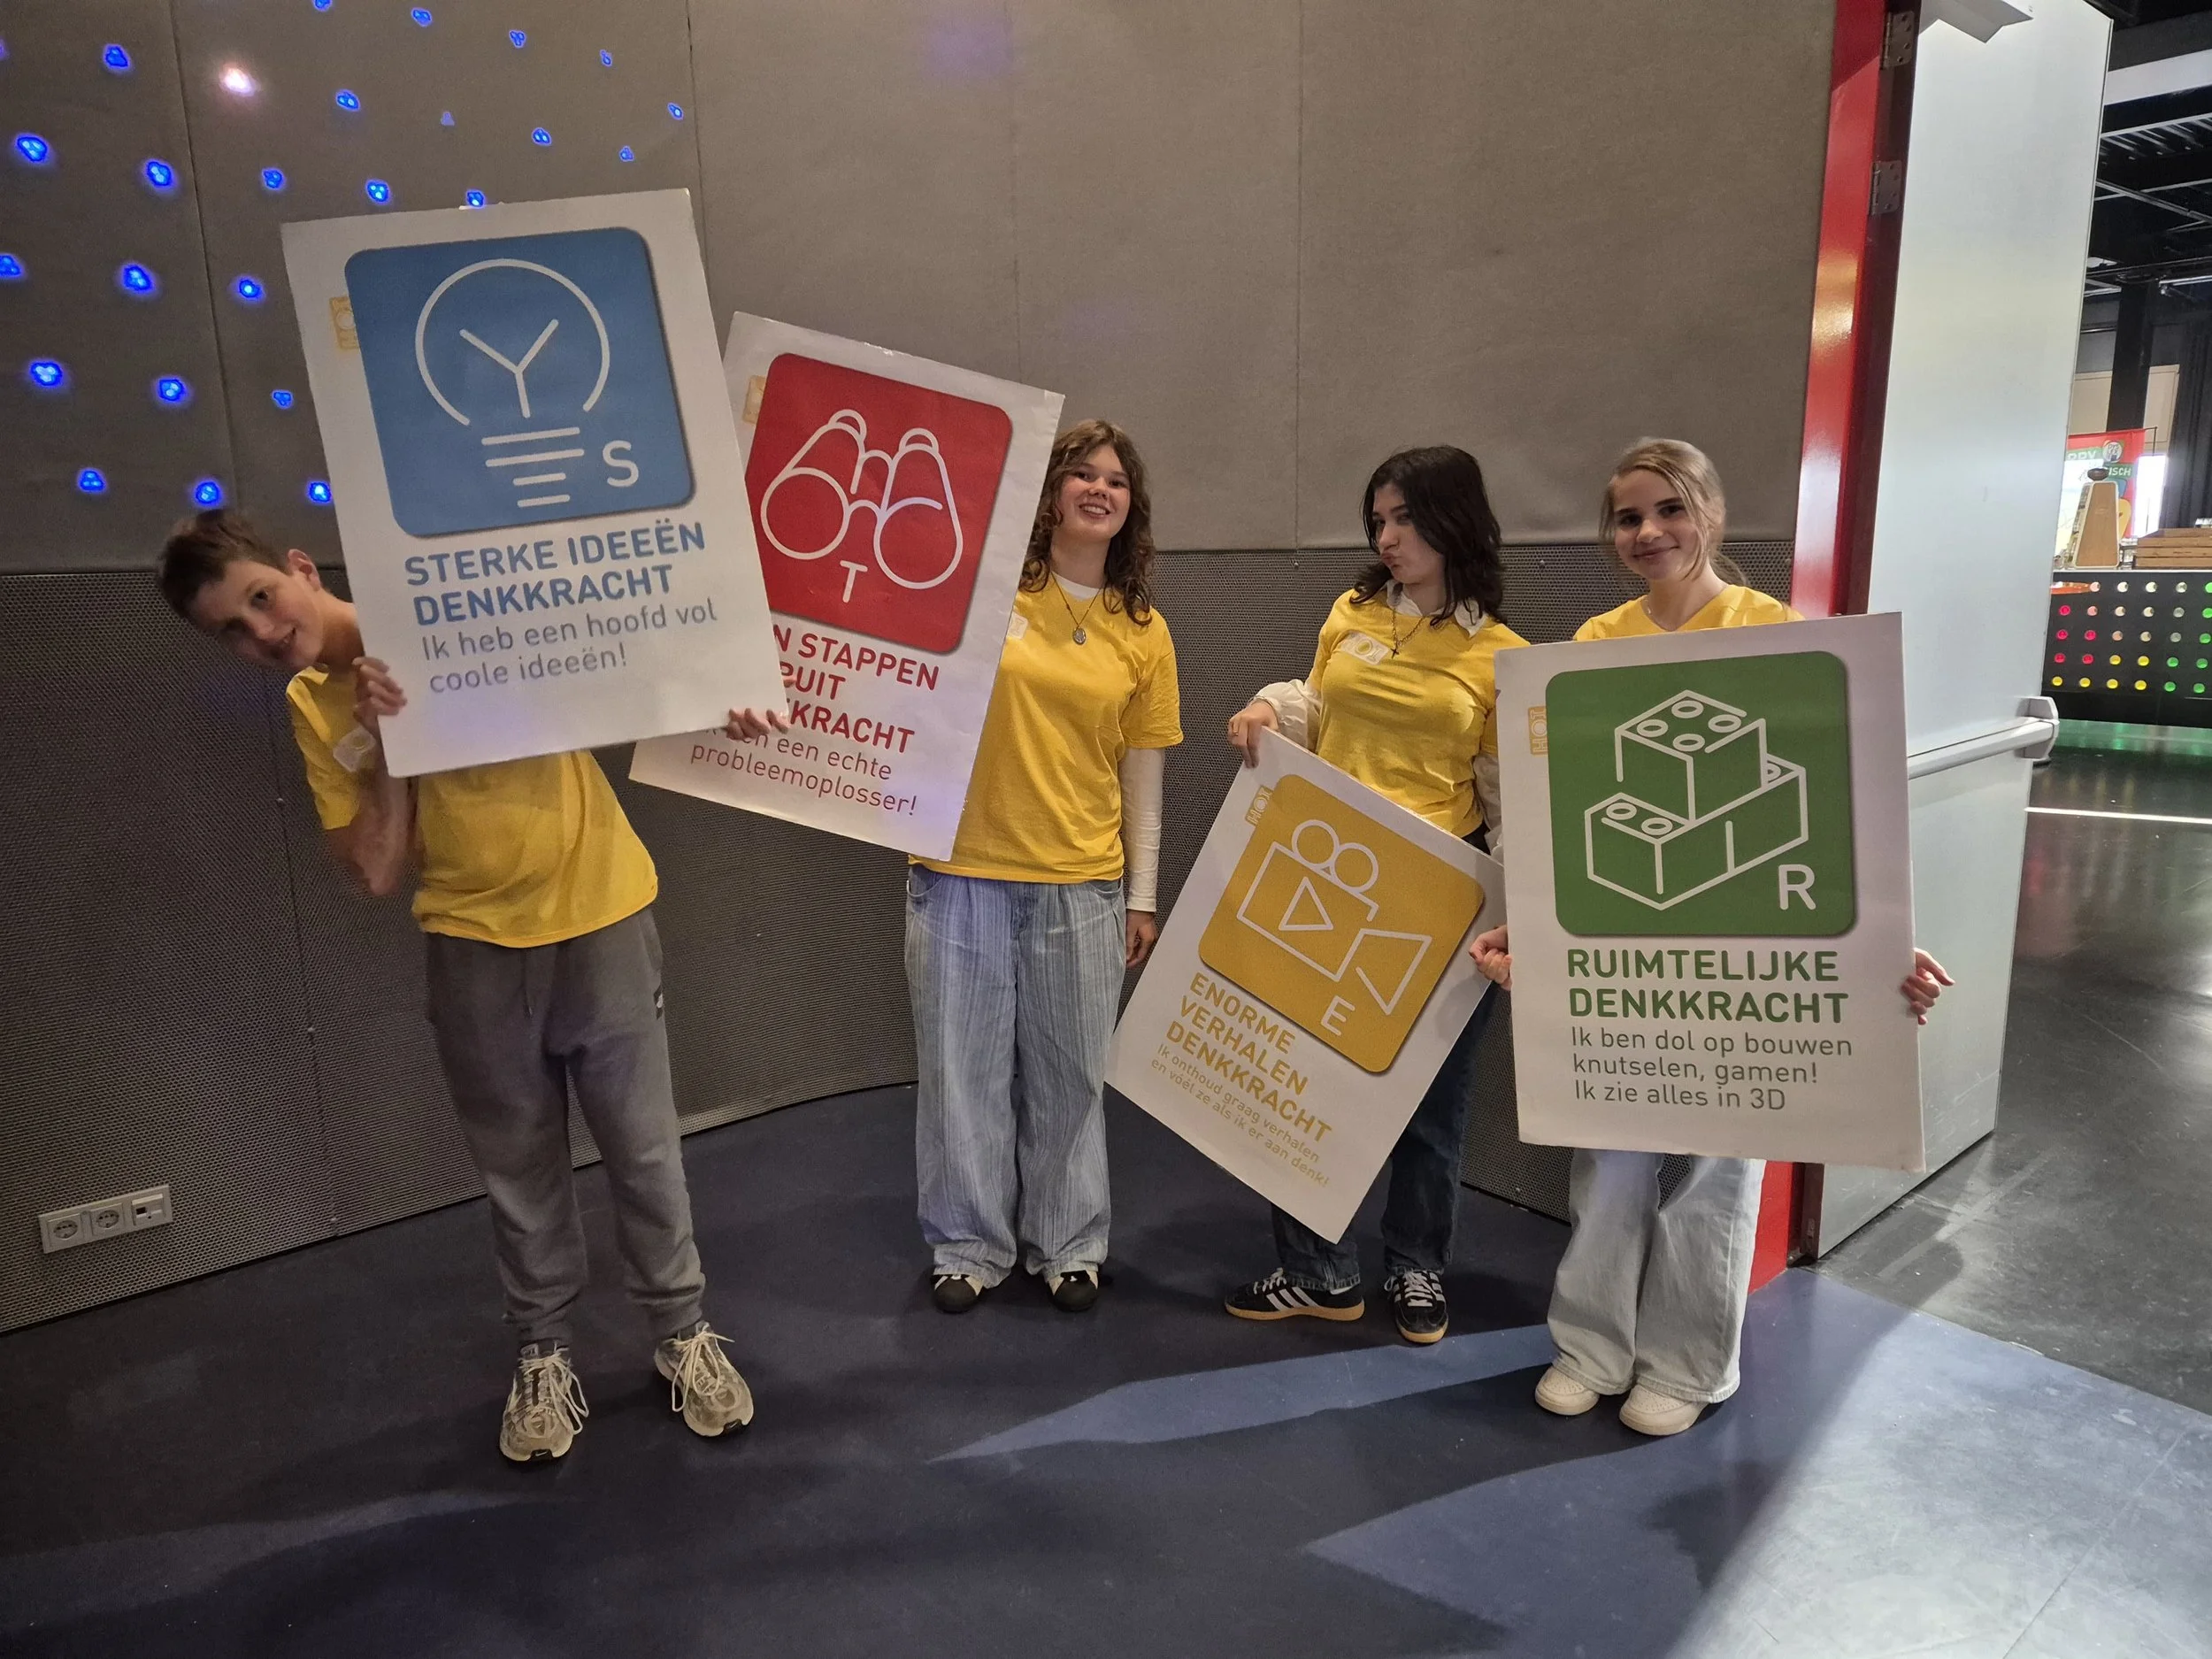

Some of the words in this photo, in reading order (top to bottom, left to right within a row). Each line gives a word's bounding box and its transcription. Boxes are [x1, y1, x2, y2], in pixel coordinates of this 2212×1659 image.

[602, 441, 639, 488] S
[404, 540, 557, 586] STERKE
[568, 518, 704, 565] IDEEËN
[413, 564, 672, 626] DENKKRACHT
[840, 560, 868, 603] T
[422, 635, 450, 660] Ik
[458, 626, 513, 655] heb
[525, 623, 578, 645] een
[587, 604, 666, 638] hoofd
[676, 597, 717, 625] vol
[429, 662, 508, 692] coole
[518, 642, 626, 680] ideeën!
[798, 633, 939, 690] STAPPEN
[787, 698, 915, 753] KRACHT
[691, 742, 917, 815] probleemoplosser!
[777, 738, 818, 762] een
[827, 751, 891, 780] echte
[1778, 864, 1816, 910] R
[1568, 949, 1839, 982] RUIMTELIJKE
[1190, 972, 1295, 1054] ENORME
[1320, 995, 1356, 1036] E
[1570, 988, 1849, 1023] DENKKRACHT
[1181, 995, 1308, 1094] VERHALEN
[1571, 1025, 1593, 1046] Ik
[1601, 1027, 1646, 1048] ben
[1655, 1030, 1694, 1050] dol
[1703, 1036, 1734, 1057] op
[1745, 1033, 1852, 1056] bouwen
[1167, 1021, 1332, 1141] DENKKRACHT
[1573, 1053, 1704, 1081] knutselen,
[1715, 1062, 1816, 1085] gamen!
[1576, 1079, 1596, 1101] Ik
[1604, 1081, 1638, 1102] zie
[1647, 1084, 1708, 1106] alles
[1718, 1087, 1740, 1107] in
[1750, 1088, 1785, 1110] 3D
[1151, 1059, 1166, 1073] en
[1196, 1090, 1210, 1103] ze
[1213, 1102, 1231, 1119] als
[1234, 1115, 1245, 1129] ik
[1248, 1126, 1263, 1140] er
[1266, 1140, 1287, 1158] aan
[1157, 1043, 1170, 1057] Ik
[1171, 1056, 1223, 1094] onthoud
[1225, 1093, 1260, 1123] graag
[1263, 1118, 1319, 1162] verhalen
